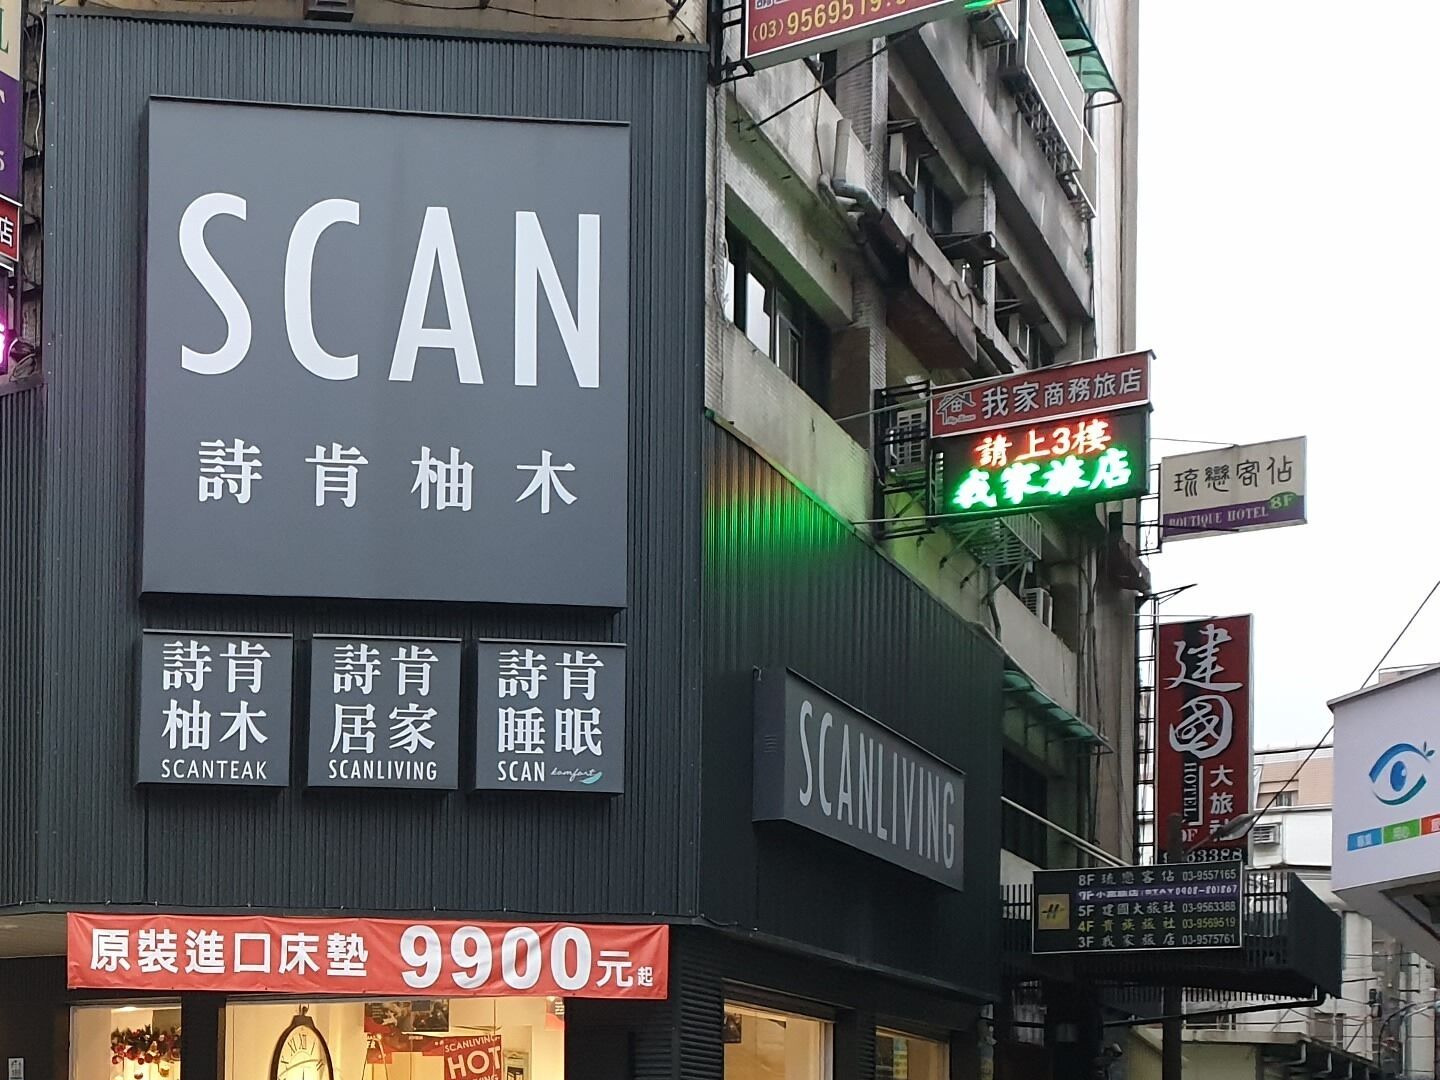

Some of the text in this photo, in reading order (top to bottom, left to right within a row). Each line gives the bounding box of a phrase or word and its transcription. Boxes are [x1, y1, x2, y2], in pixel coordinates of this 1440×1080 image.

[178, 192, 600, 388] SCAN
[981, 368, 1142, 419] 我家商務旅店
[198, 438, 577, 514] 詩肯柚木
[1169, 506, 1268, 528] BOUTIQUE HOTEL
[1270, 494, 1294, 509] 8F
[162, 640, 271, 693] 詩肯
[333, 644, 439, 697] 詩肯
[498, 649, 604, 701] 詩肯
[161, 700, 268, 751] 柚木
[330, 703, 437, 754] 居家
[498, 706, 604, 757] 睡眠
[161, 759, 268, 780] SCANTEAK
[328, 760, 437, 782] SCANLIVING
[497, 760, 545, 782] SCAN
[799, 700, 955, 869] SCANLIVING
[1184, 762, 1197, 816] HOTEL
[1078, 873, 1095, 886] 8F
[1078, 904, 1095, 917] 5F
[1078, 920, 1095, 932] 4F
[91, 928, 369, 977] 原裝進口床墊
[1078, 936, 1095, 948] 3F
[445, 1035, 501, 1053] SCANLIVING
[447, 1046, 501, 1080] HOT
